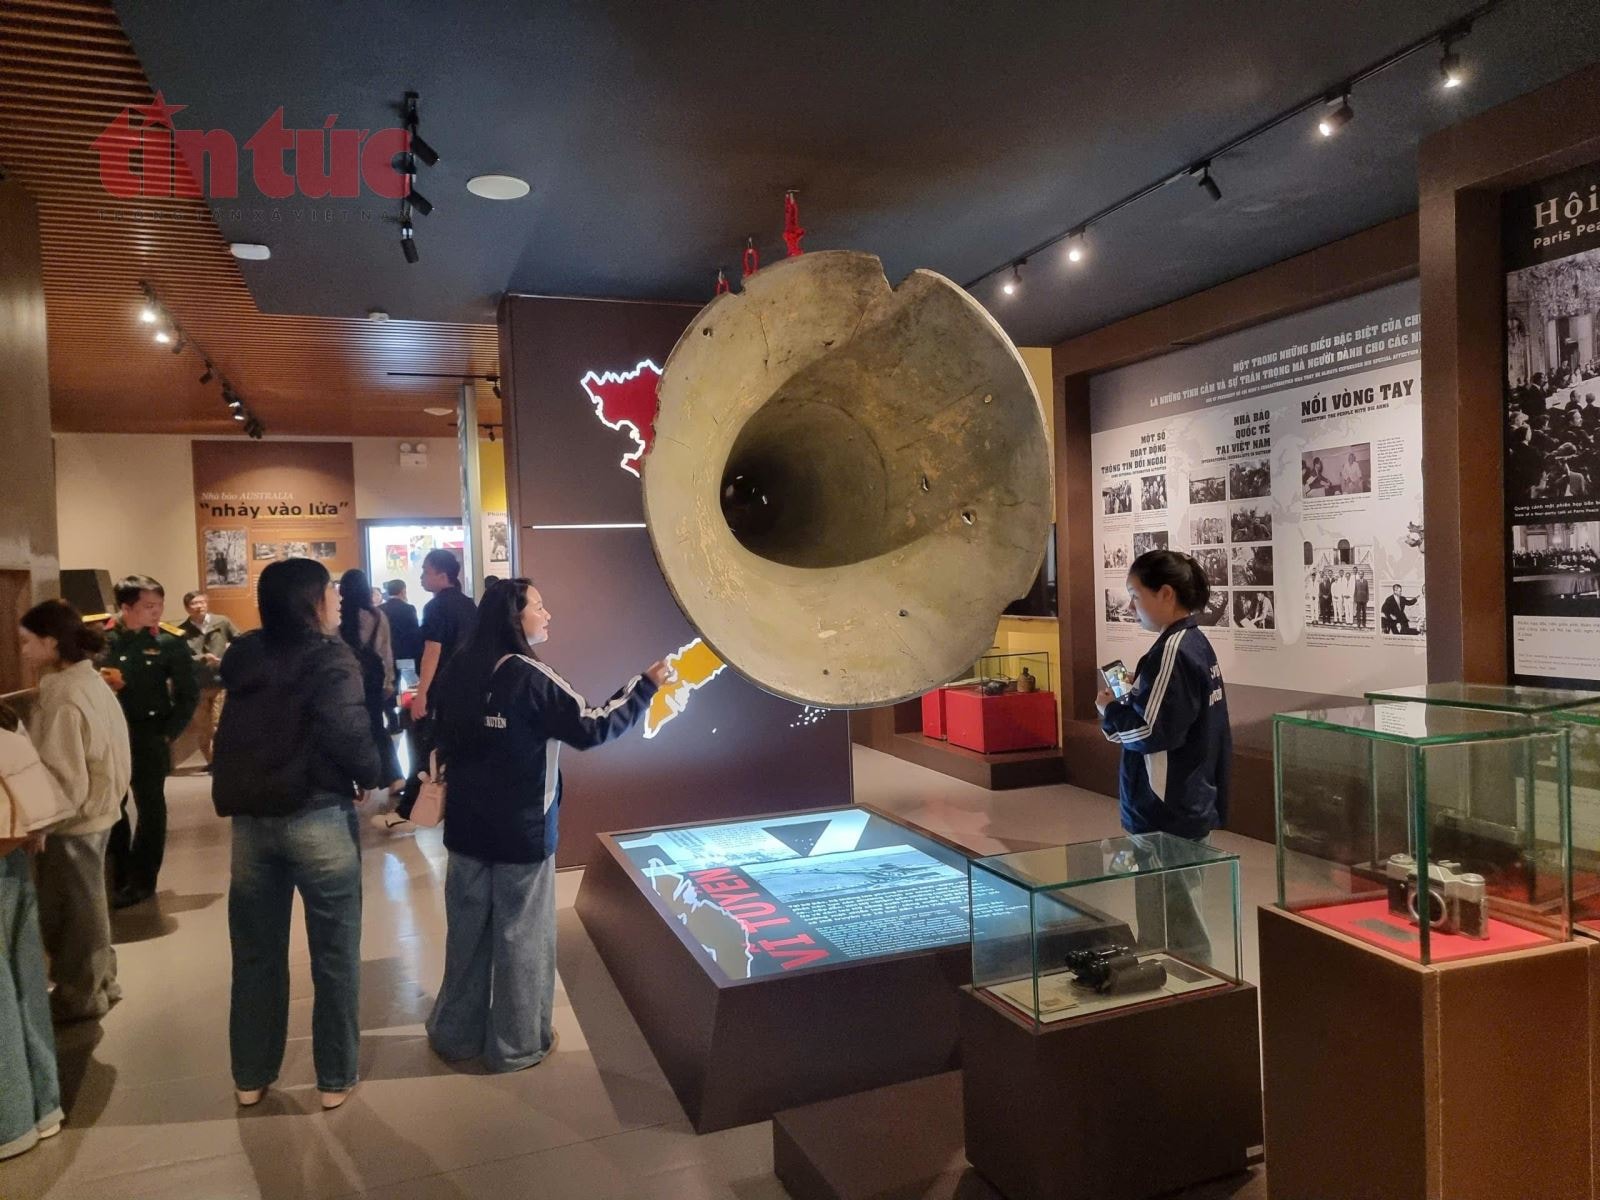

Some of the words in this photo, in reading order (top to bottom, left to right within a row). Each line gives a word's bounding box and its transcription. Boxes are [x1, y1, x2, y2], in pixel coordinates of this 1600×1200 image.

[1534, 184, 1600, 230] Hội
[1533, 229, 1571, 249] Paris
[1252, 352, 1277, 367] TRONG
[1280, 343, 1309, 361] NHỮNG
[1355, 324, 1379, 341] BIỆT
[1381, 317, 1402, 334] CỦA
[1216, 377, 1226, 391] VÀ
[1292, 358, 1306, 373] MÀ
[1365, 340, 1385, 354] CHO
[1387, 333, 1408, 349] CÁC
[1301, 391, 1327, 417] NỐI
[1332, 387, 1374, 411] VÒNG
[1379, 379, 1414, 401] TAY
[1233, 411, 1251, 426] NHÀ
[1253, 408, 1270, 423] BÁO
[1252, 437, 1271, 450] NAM
[239, 491, 294, 500] AUSTRALIA
[267, 501, 303, 516] vào
